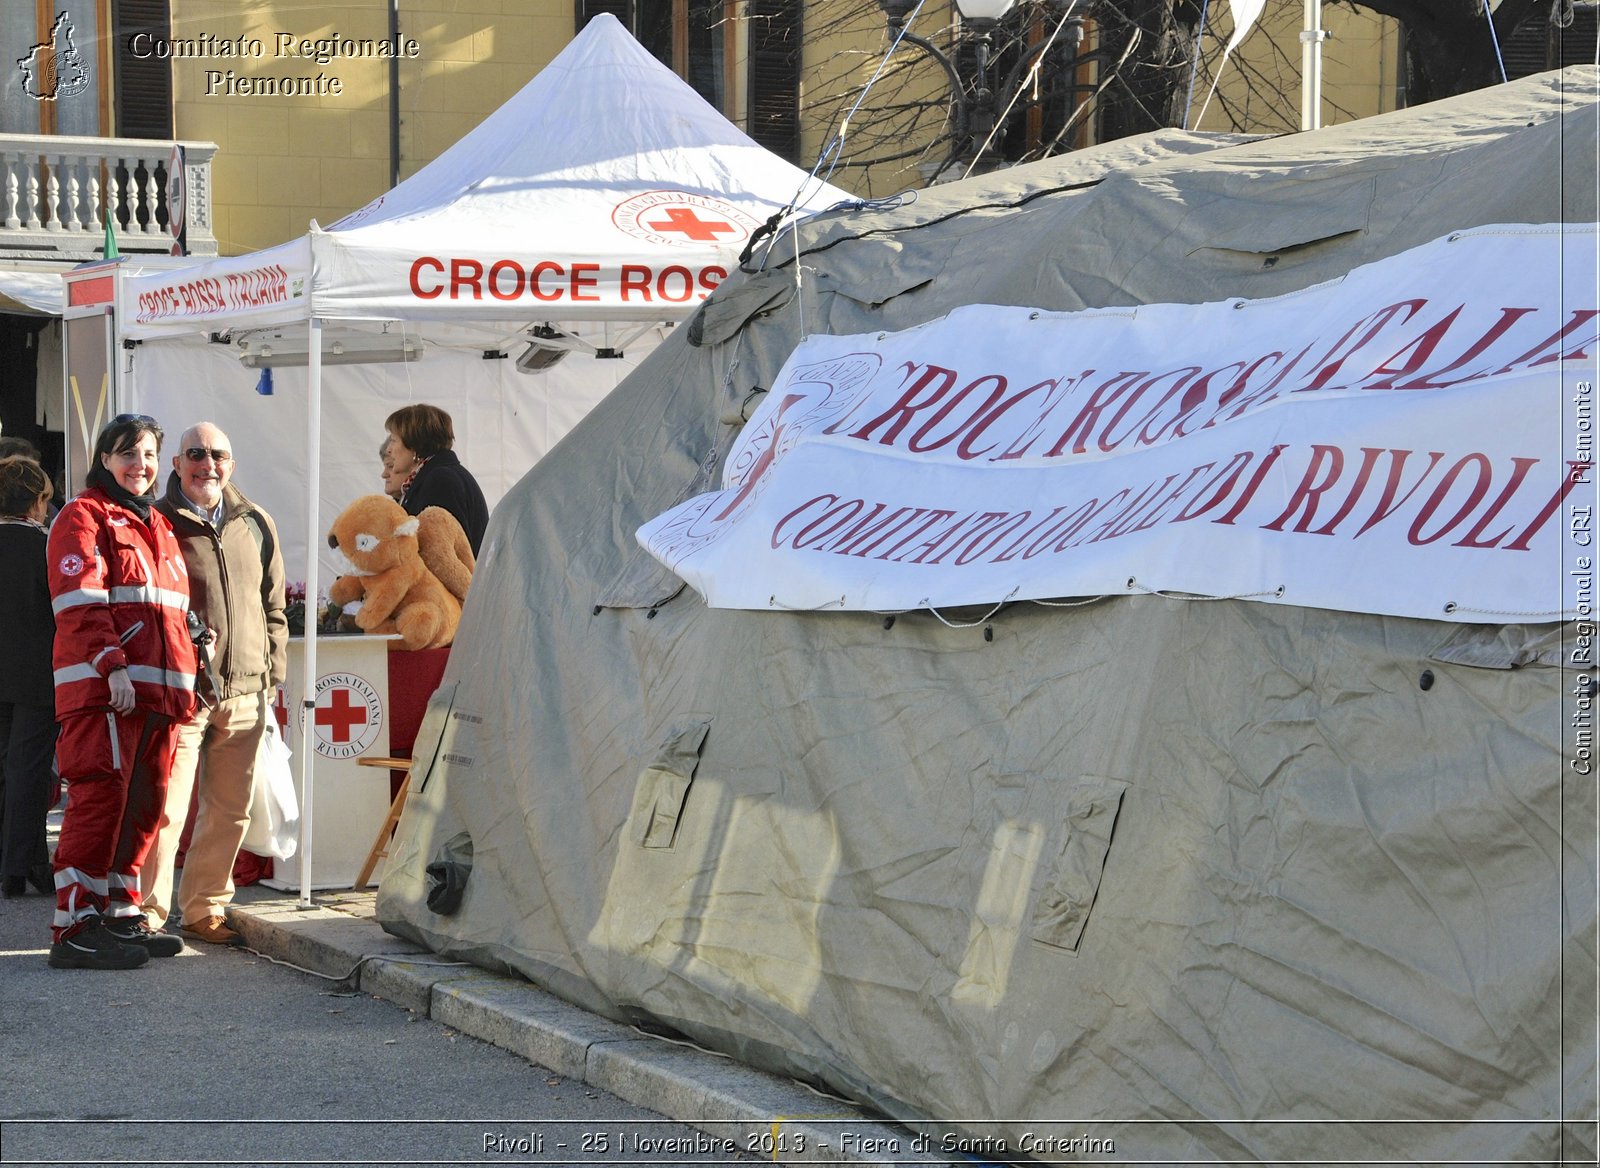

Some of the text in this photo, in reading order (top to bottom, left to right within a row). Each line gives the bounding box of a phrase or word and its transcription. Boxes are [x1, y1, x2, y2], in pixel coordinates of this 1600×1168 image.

[178, 278, 226, 315] ROSSA
[225, 264, 288, 312] ITALIANA
[409, 256, 600, 301] CROCE
[822, 360, 1096, 462] CROCE
[771, 493, 1032, 566] COMITATO
[988, 461, 1218, 564] LOCALE
[1168, 444, 1290, 525] DI
[1259, 443, 1597, 551] RIVOLI
[315, 675, 380, 727] ROSSA ITALIANA
[317, 740, 365, 757] RIVOLI
